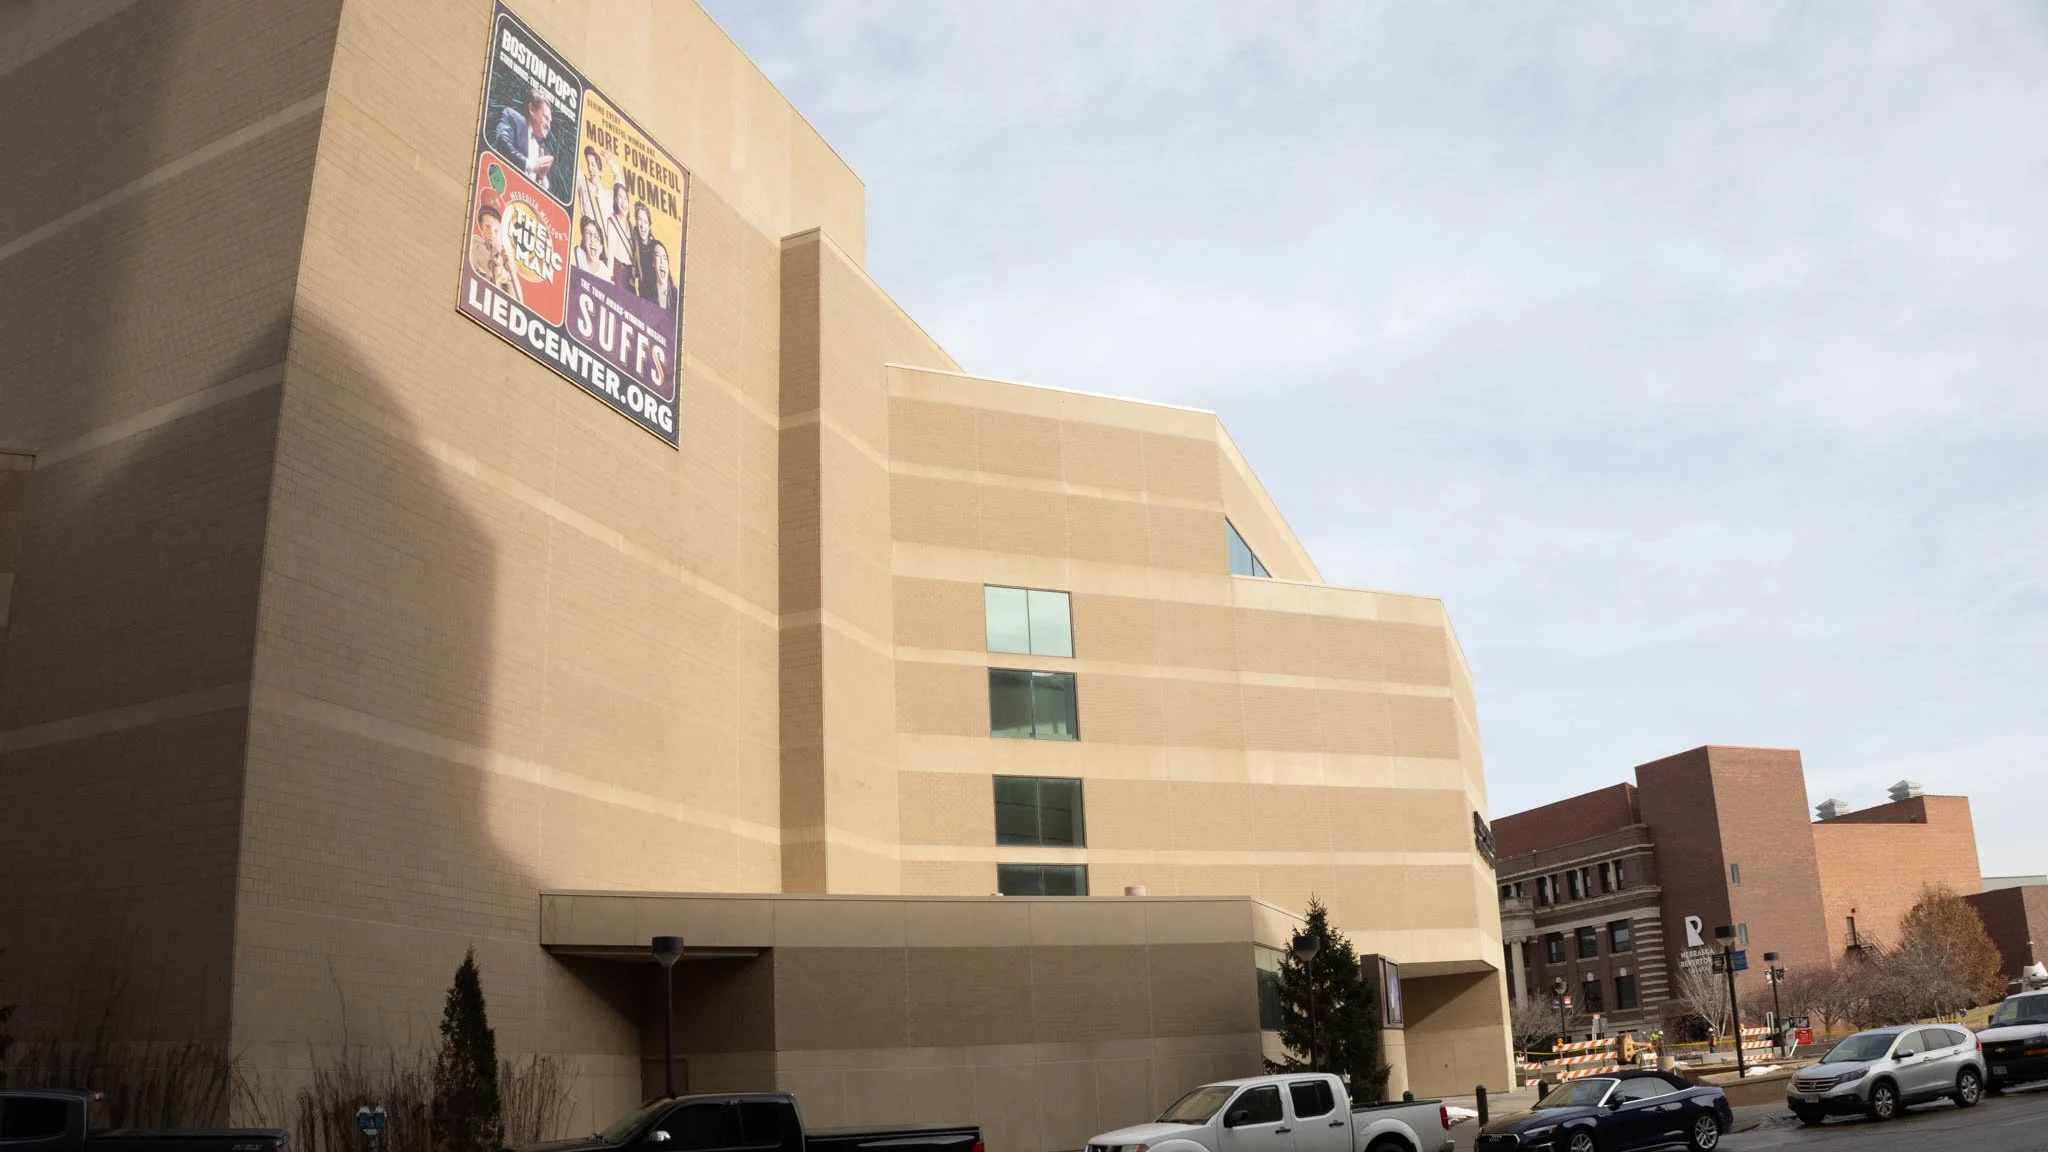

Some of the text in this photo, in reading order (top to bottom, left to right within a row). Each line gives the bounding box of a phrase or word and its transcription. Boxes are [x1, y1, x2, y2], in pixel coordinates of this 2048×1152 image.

[502, 28, 578, 109] BOSTON POPS
[587, 98, 621, 124] BEHIND EVERY
[602, 118, 627, 140] POWERFUL
[586, 119, 681, 194] MORE POWERFUL
[623, 166, 682, 223] WOMEN.
[508, 219, 563, 272] MUSIC
[514, 206, 548, 241] THE
[515, 242, 554, 284] MAN
[577, 293, 667, 387] SUFFS
[580, 277, 591, 292] THE
[646, 325, 667, 348] MUSICAL
[468, 278, 674, 434] LIEDCENTER.ORG
[1680, 947, 1715, 959] NEBRASKA
